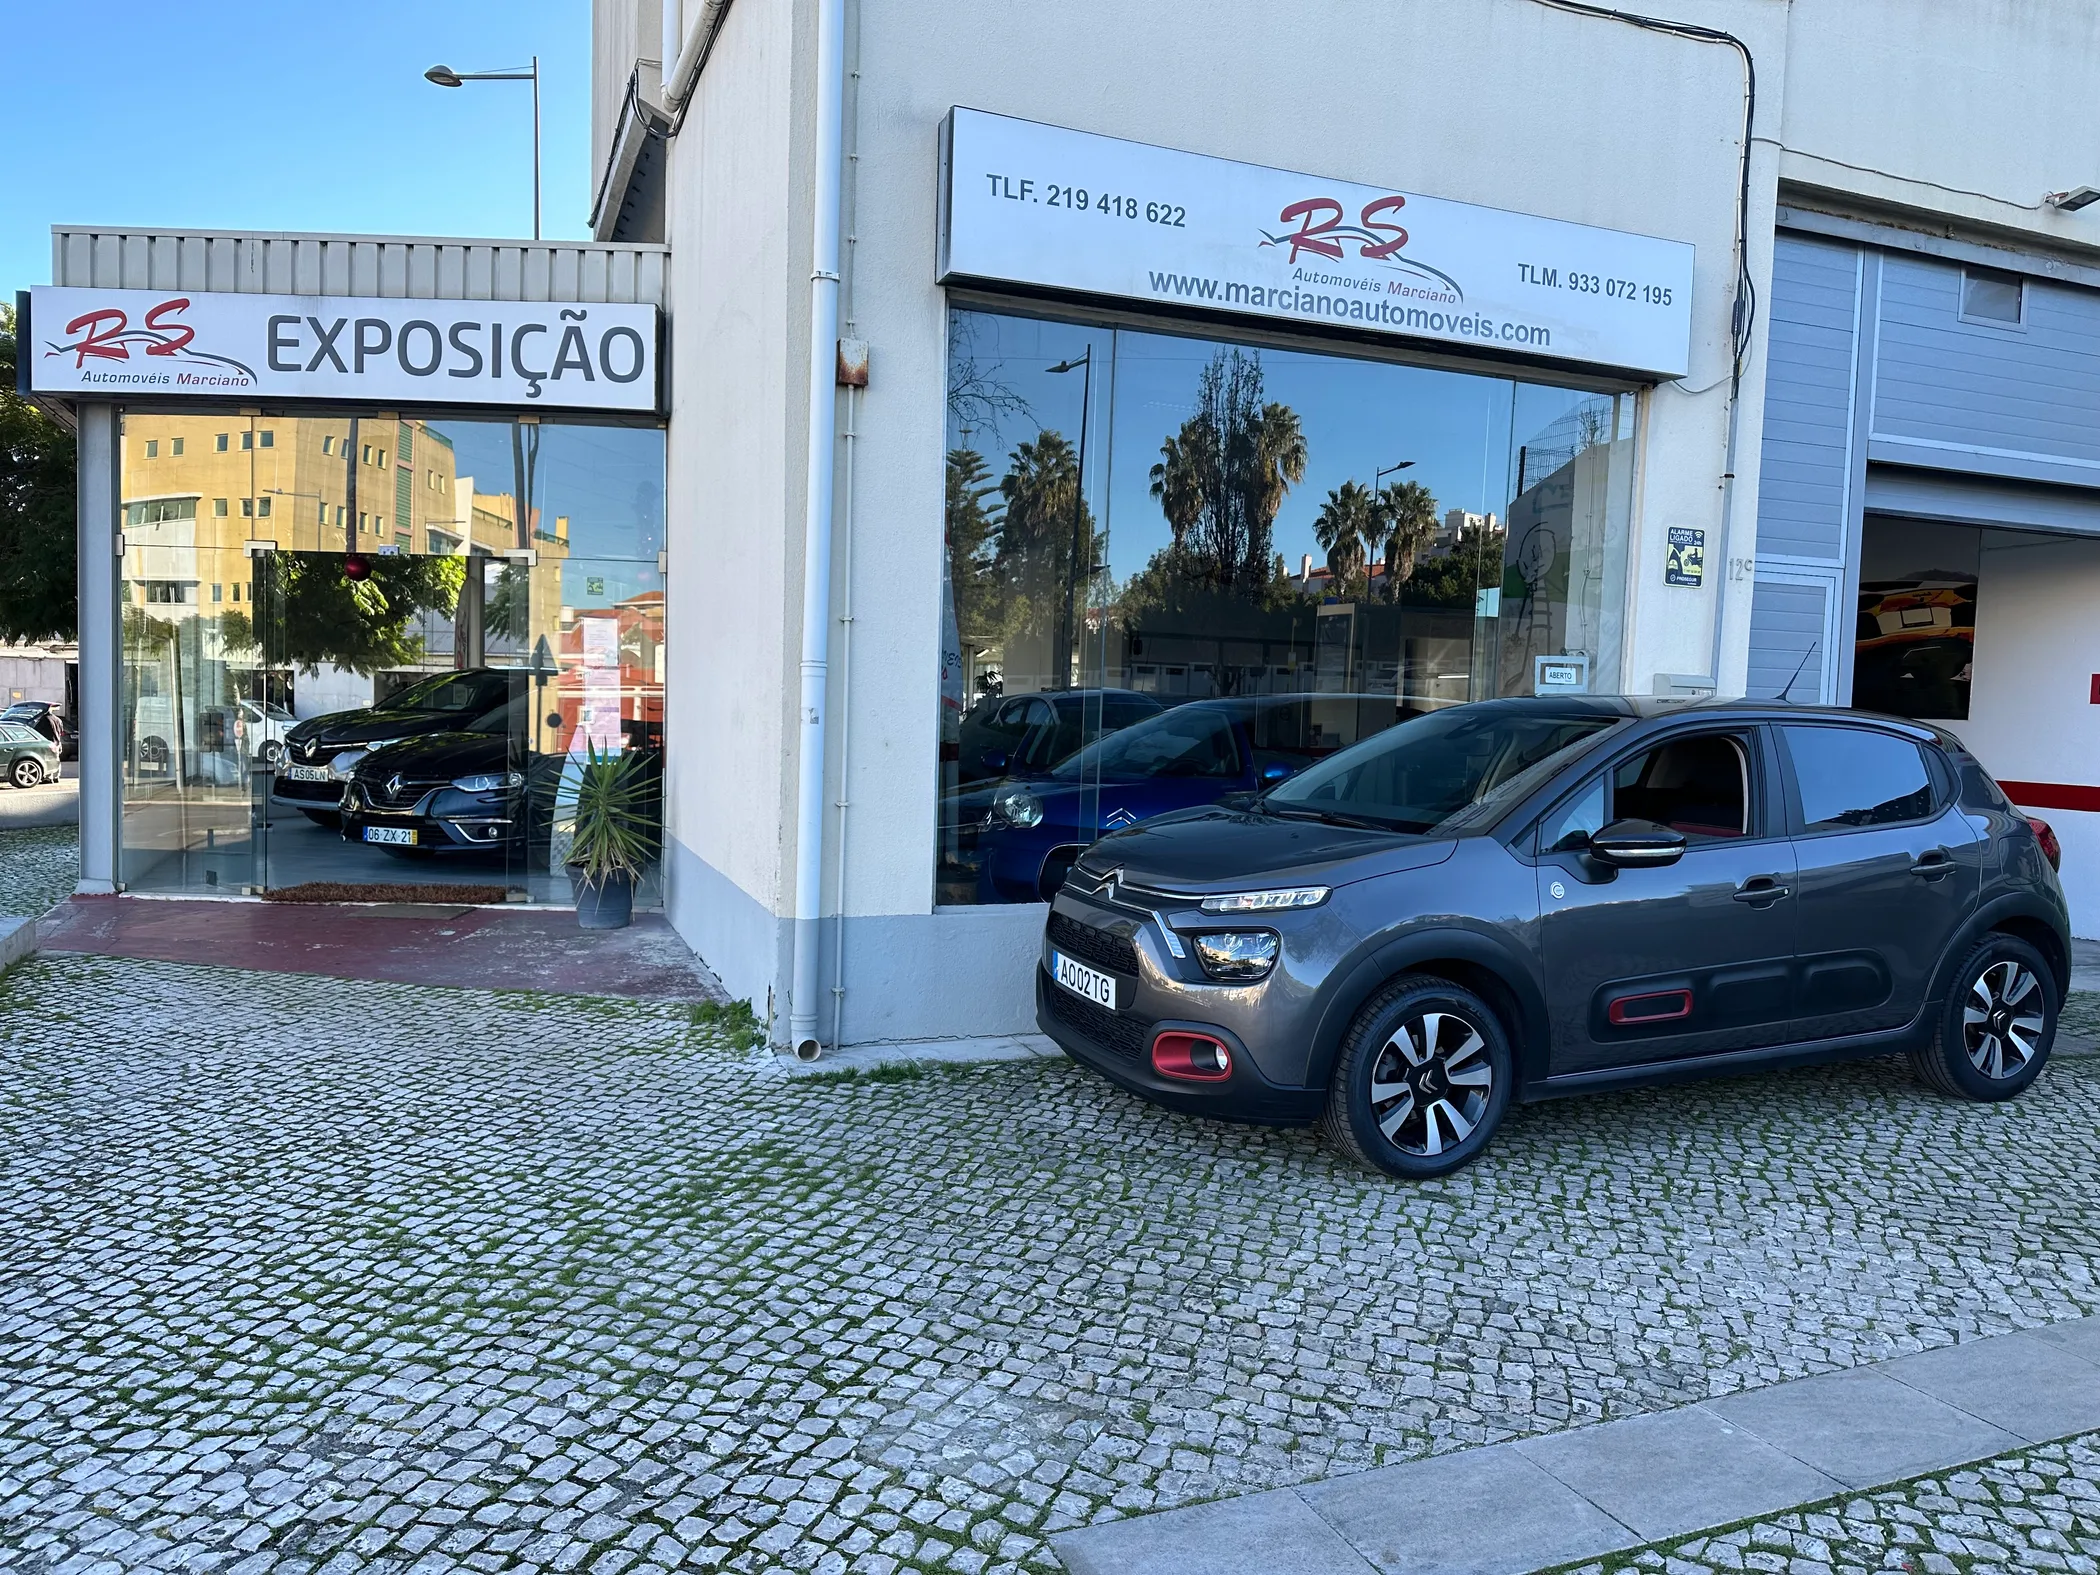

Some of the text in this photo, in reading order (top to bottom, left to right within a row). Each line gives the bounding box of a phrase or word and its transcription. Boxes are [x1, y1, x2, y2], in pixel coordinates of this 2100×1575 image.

[987, 173, 1186, 228] TLF. 219 418 622
[1292, 267, 1456, 304] Automovéis Marciano
[1517, 263, 1672, 306] TLM. 933 072 195
[1149, 270, 1550, 346] www.marcianoautomoveis.com
[267, 309, 645, 398] EXPOSIÇÃO
[81, 370, 249, 387] Automovéis Marciano
[1670, 528, 1694, 536] ALARME
[1670, 534, 1694, 542] LIGADO
[1549, 671, 1572, 680] ABERTO
